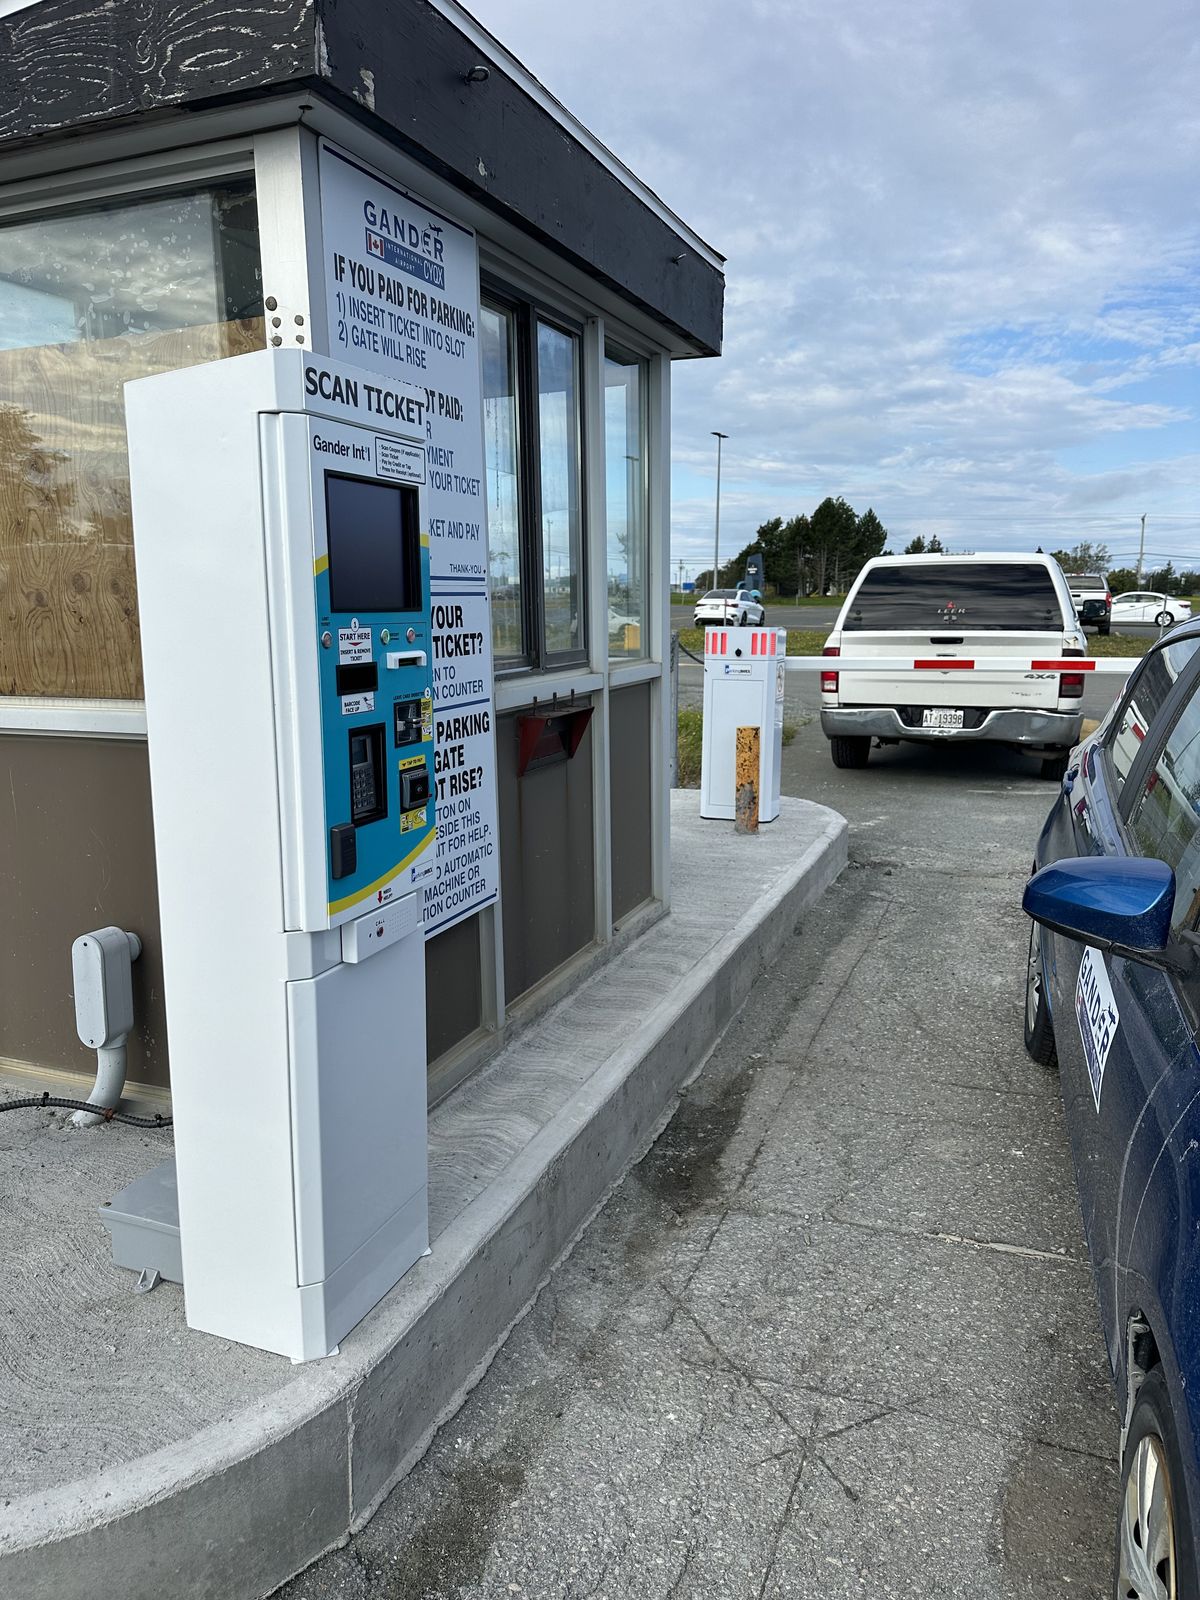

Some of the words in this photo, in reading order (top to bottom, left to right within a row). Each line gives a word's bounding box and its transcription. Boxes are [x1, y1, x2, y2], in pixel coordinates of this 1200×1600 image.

[364, 200, 444, 263] GANDER
[385, 242, 423, 266] INTERNATIONAL
[423, 260, 443, 287] CYQX
[334, 252, 345, 282] IF
[349, 259, 375, 296] YOU
[378, 272, 404, 308] PAID
[407, 286, 428, 318] FOR
[430, 296, 475, 339] PARKING:
[336, 291, 346, 320] 1)
[349, 295, 385, 329] INSERT
[388, 311, 420, 342] TICKET
[422, 325, 443, 350] INTO
[445, 334, 466, 359] SLOT
[338, 319, 349, 348] 2)
[351, 324, 379, 354] GATE
[381, 335, 404, 362] WILL
[406, 344, 427, 370] RISE
[305, 366, 359, 408] SCAN
[363, 383, 425, 426] TICKET
[438, 392, 464, 422] PAID:
[313, 434, 350, 457] Gander
[429, 469, 453, 492] YOUR
[454, 474, 481, 496] TICKET
[447, 520, 464, 539] AND
[465, 522, 480, 541] PAY
[449, 563, 482, 574] THANK-YOU
[340, 633, 356, 641] START
[357, 632, 371, 640] HERE
[432, 632, 483, 659] TICKET?
[442, 665, 456, 681] TO
[441, 679, 484, 699] COUNTER
[344, 700, 361, 708] BARCODE
[436, 711, 490, 744] PARKING
[434, 744, 465, 774] GATE
[450, 766, 483, 797] RISE?
[457, 797, 471, 813] ON
[461, 811, 481, 829] THIS
[448, 833, 466, 853] FOR
[444, 842, 493, 877] AUTOMATIC
[424, 871, 466, 904] MACHINE
[467, 864, 480, 881] OR
[445, 878, 486, 909] COUNTER
[375, 918, 385, 927] CALL
